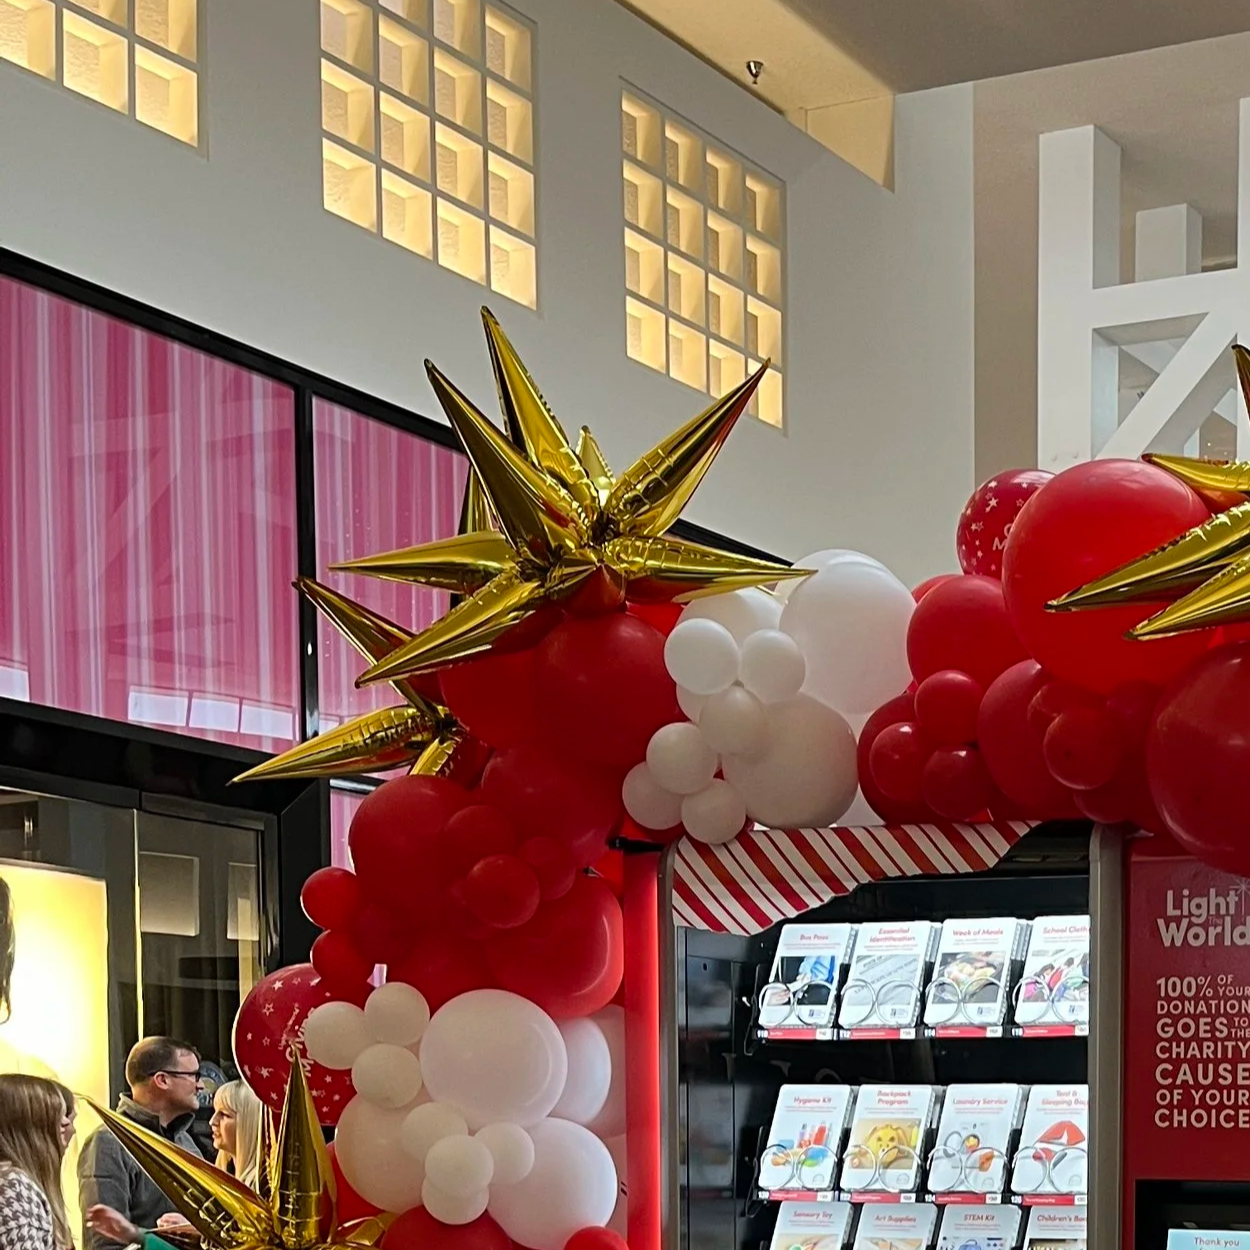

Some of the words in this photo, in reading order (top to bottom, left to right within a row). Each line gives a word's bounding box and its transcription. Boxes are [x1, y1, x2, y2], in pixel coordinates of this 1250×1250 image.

[1167, 888, 1239, 924] Light
[972, 928, 981, 936] of
[1156, 975, 1214, 998] 100%
[1217, 974, 1234, 985] OF
[1156, 1016, 1229, 1039] GOES
[1233, 1017, 1249, 1028] TO
[1155, 1062, 1250, 1086] CAUSE
[1155, 1088, 1183, 1106] OF
[1190, 1088, 1250, 1106] YOUR
[1154, 1108, 1250, 1129] CHOICE
[963, 1213, 984, 1222] STEM
[984, 1213, 996, 1221] Kit
[1194, 1236, 1221, 1247] Thank
[1223, 1239, 1240, 1249] you
